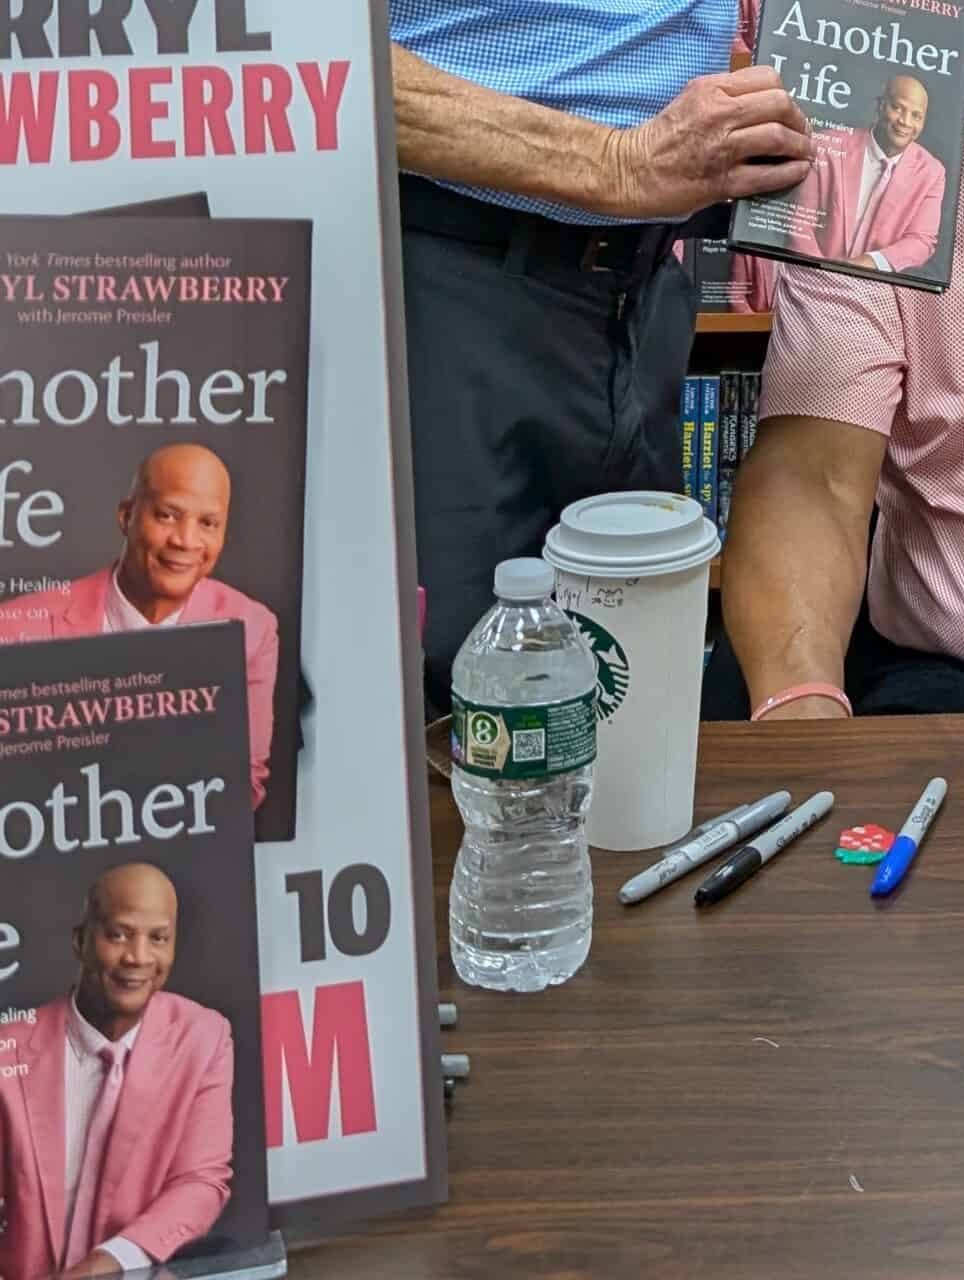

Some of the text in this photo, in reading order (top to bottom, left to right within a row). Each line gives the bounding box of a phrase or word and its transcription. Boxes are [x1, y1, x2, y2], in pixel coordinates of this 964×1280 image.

[772, 0, 959, 76] Another
[770, 53, 852, 110] Life
[0, 60, 351, 166] WBERRY
[6, 253, 232, 271] York Times bestselling author
[53, 275, 289, 303] STRAWBERRY
[18, 309, 172, 325] with Jerome Preisler
[683, 421, 695, 469] Harriet
[702, 421, 716, 469] Harriet
[10, 577, 71, 598] Healing
[32, 677, 110, 697] bestselling
[114, 673, 164, 688] author
[0, 686, 220, 735] STRAWBERRY
[57, 732, 110, 749] Preisler
[0, 762, 225, 861] other
[285, 862, 393, 963] 10
